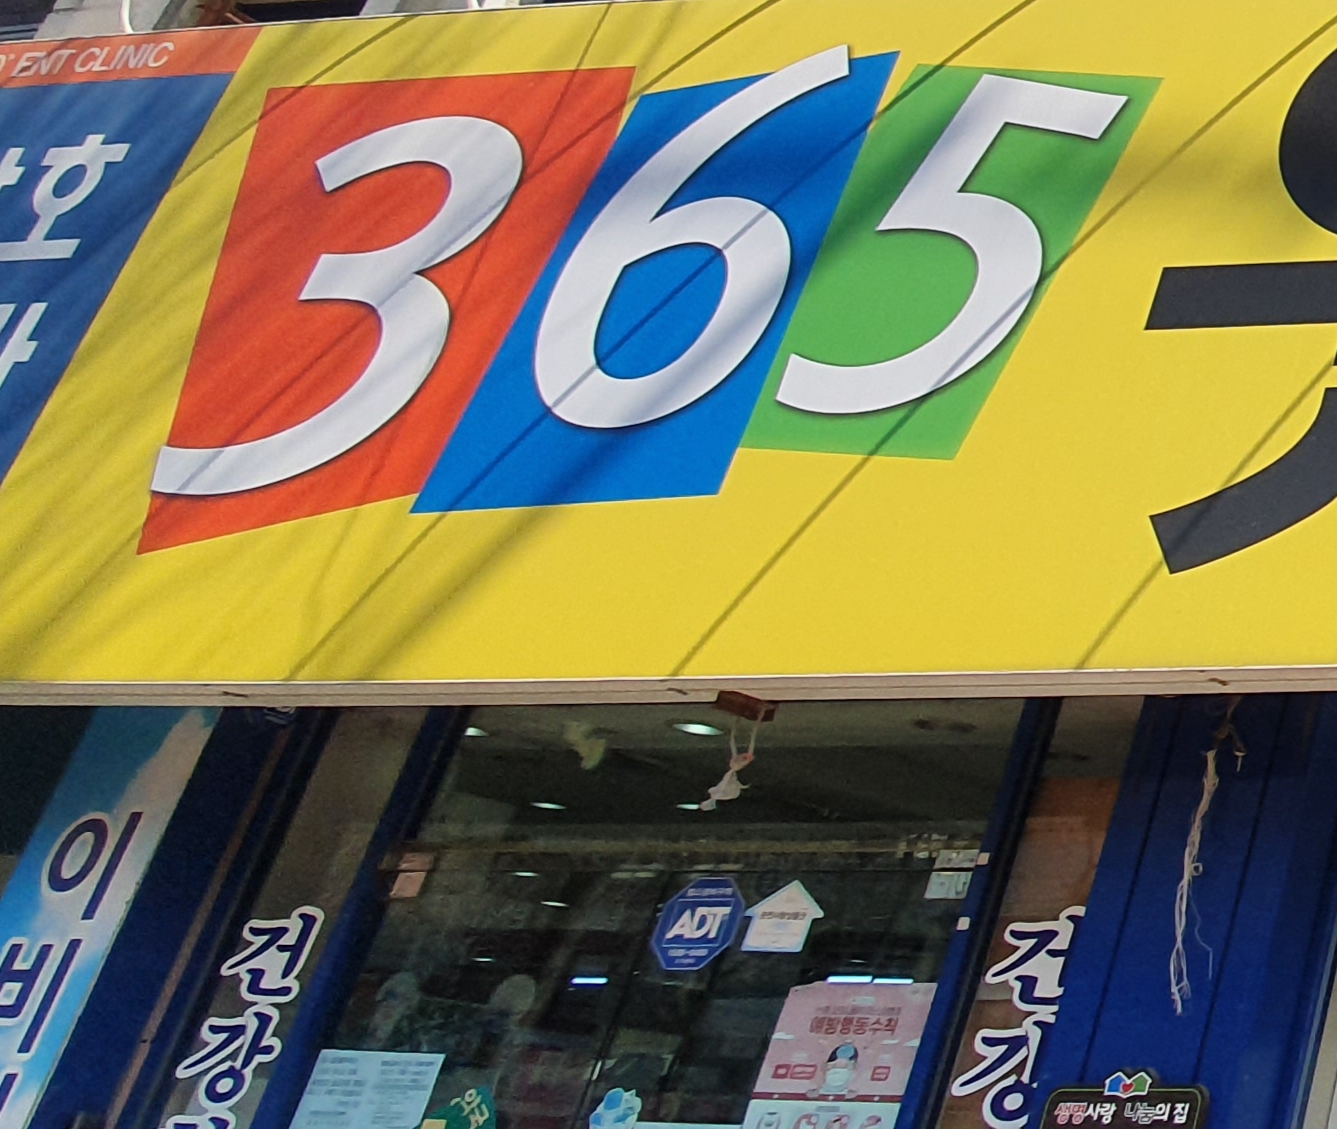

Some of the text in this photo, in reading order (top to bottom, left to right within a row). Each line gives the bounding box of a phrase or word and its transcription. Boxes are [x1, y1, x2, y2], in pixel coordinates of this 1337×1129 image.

[10, 49, 77, 78] ENT
[75, 41, 175, 73] CLINIC
[0, 134, 131, 260] 호
[151, 44, 1128, 496] 365
[0, 810, 143, 1115] 이비
[664, 906, 732, 940] ADT
[160, 906, 326, 1129] 건강
[1054, 1100, 1191, 1126] 생명사랑 나눔의 집
